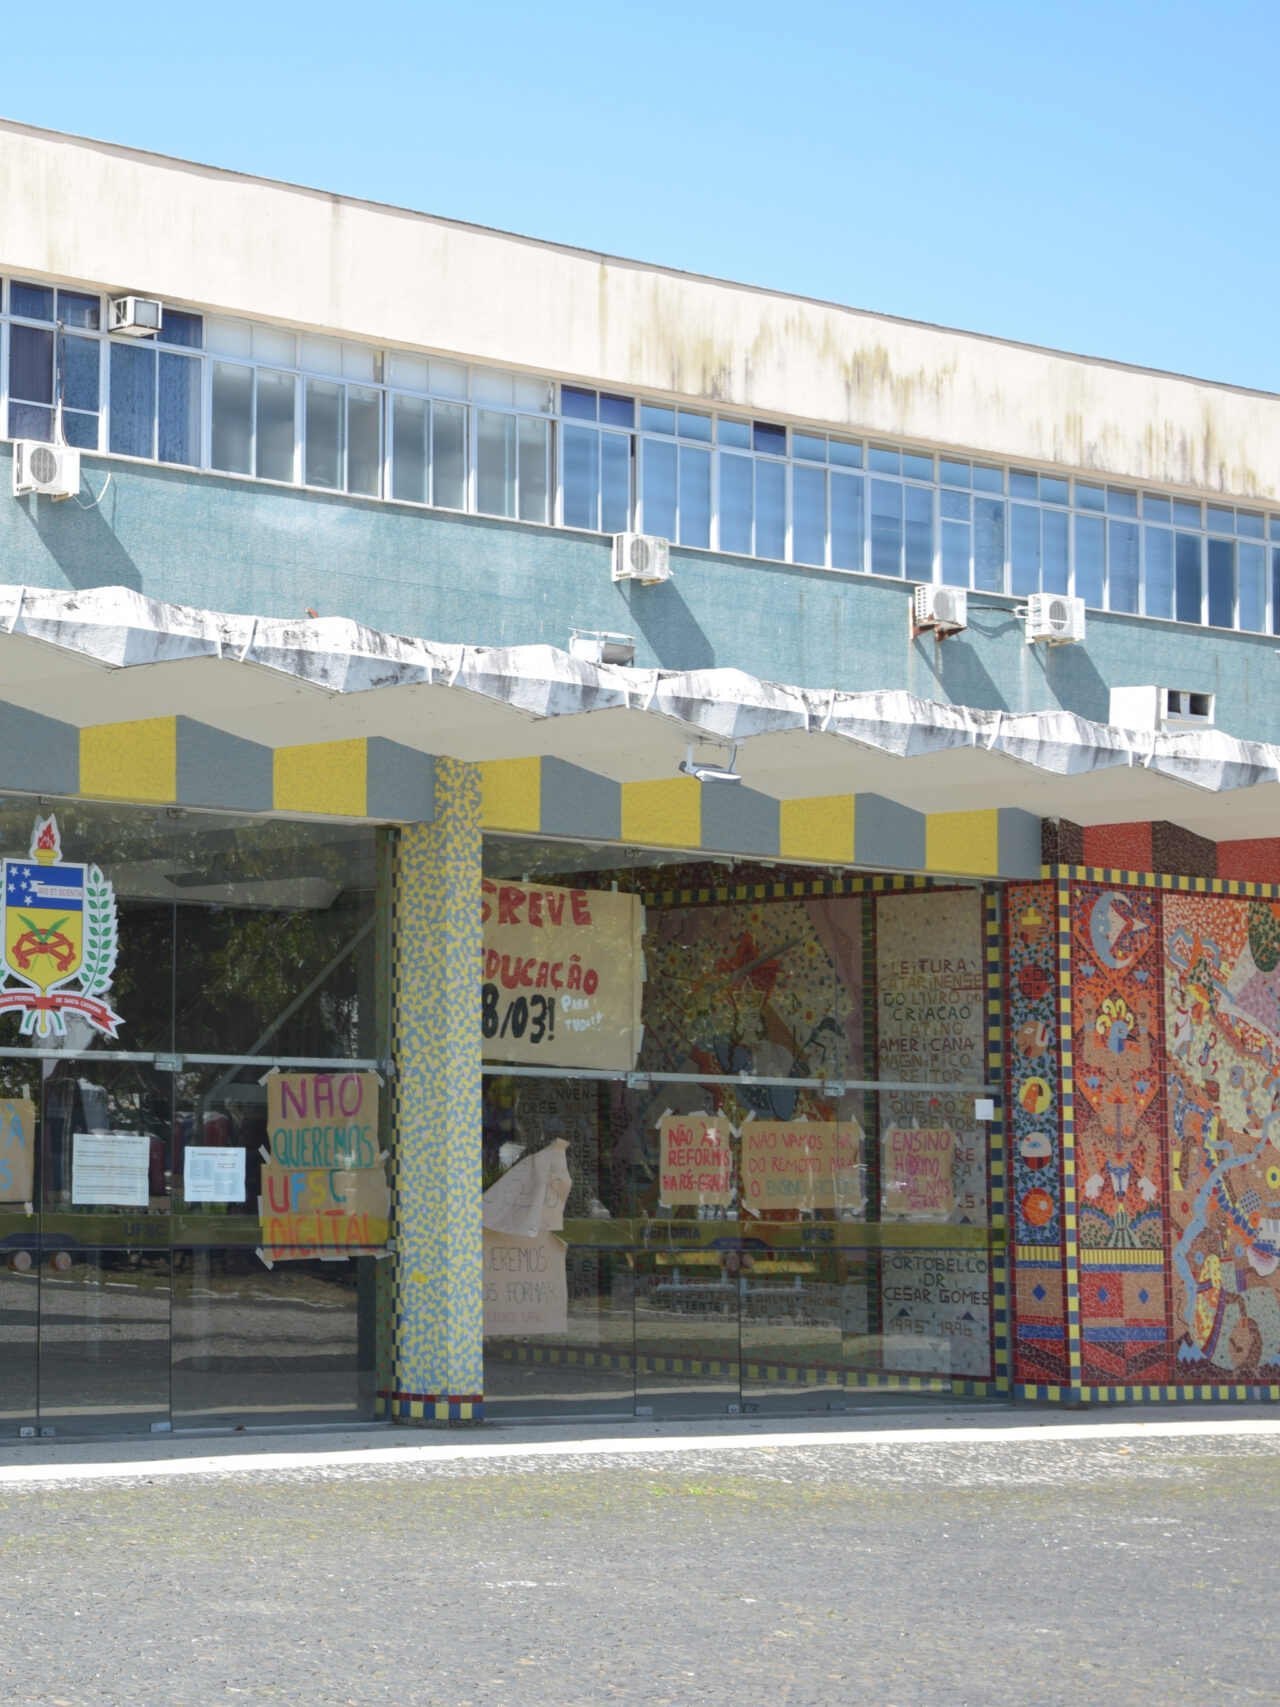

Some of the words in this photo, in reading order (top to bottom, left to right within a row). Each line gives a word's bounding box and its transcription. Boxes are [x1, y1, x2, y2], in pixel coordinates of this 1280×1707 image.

[482, 948, 599, 995] DUCAÇÃO
[911, 990, 960, 1006] LIVRO
[900, 1069, 963, 1083] REITOR
[281, 1074, 363, 1119] NÃO
[668, 1123, 694, 1147] NÃO
[748, 1131, 777, 1151] NÃO
[781, 1132, 823, 1150] VAMOS
[892, 1130, 951, 1153] ENSINO
[273, 1124, 375, 1170] QUEREMOS
[748, 1156, 767, 1174] DO
[771, 1156, 822, 1174] REMOTO
[268, 1169, 348, 1214] UFSC
[750, 1180, 761, 1198] O
[124, 1222, 166, 1237] UFSC
[271, 1208, 379, 1258] DIGITAL
[639, 1226, 701, 1240] REITORIA
[802, 1228, 834, 1242] UFSC
[882, 1255, 988, 1274] PORTOBELLO
[507, 1281, 559, 1304] FORMAR
[883, 1286, 933, 1304] CESAR
[939, 1289, 989, 1306] GOMES
[888, 1318, 930, 1334] 1995
